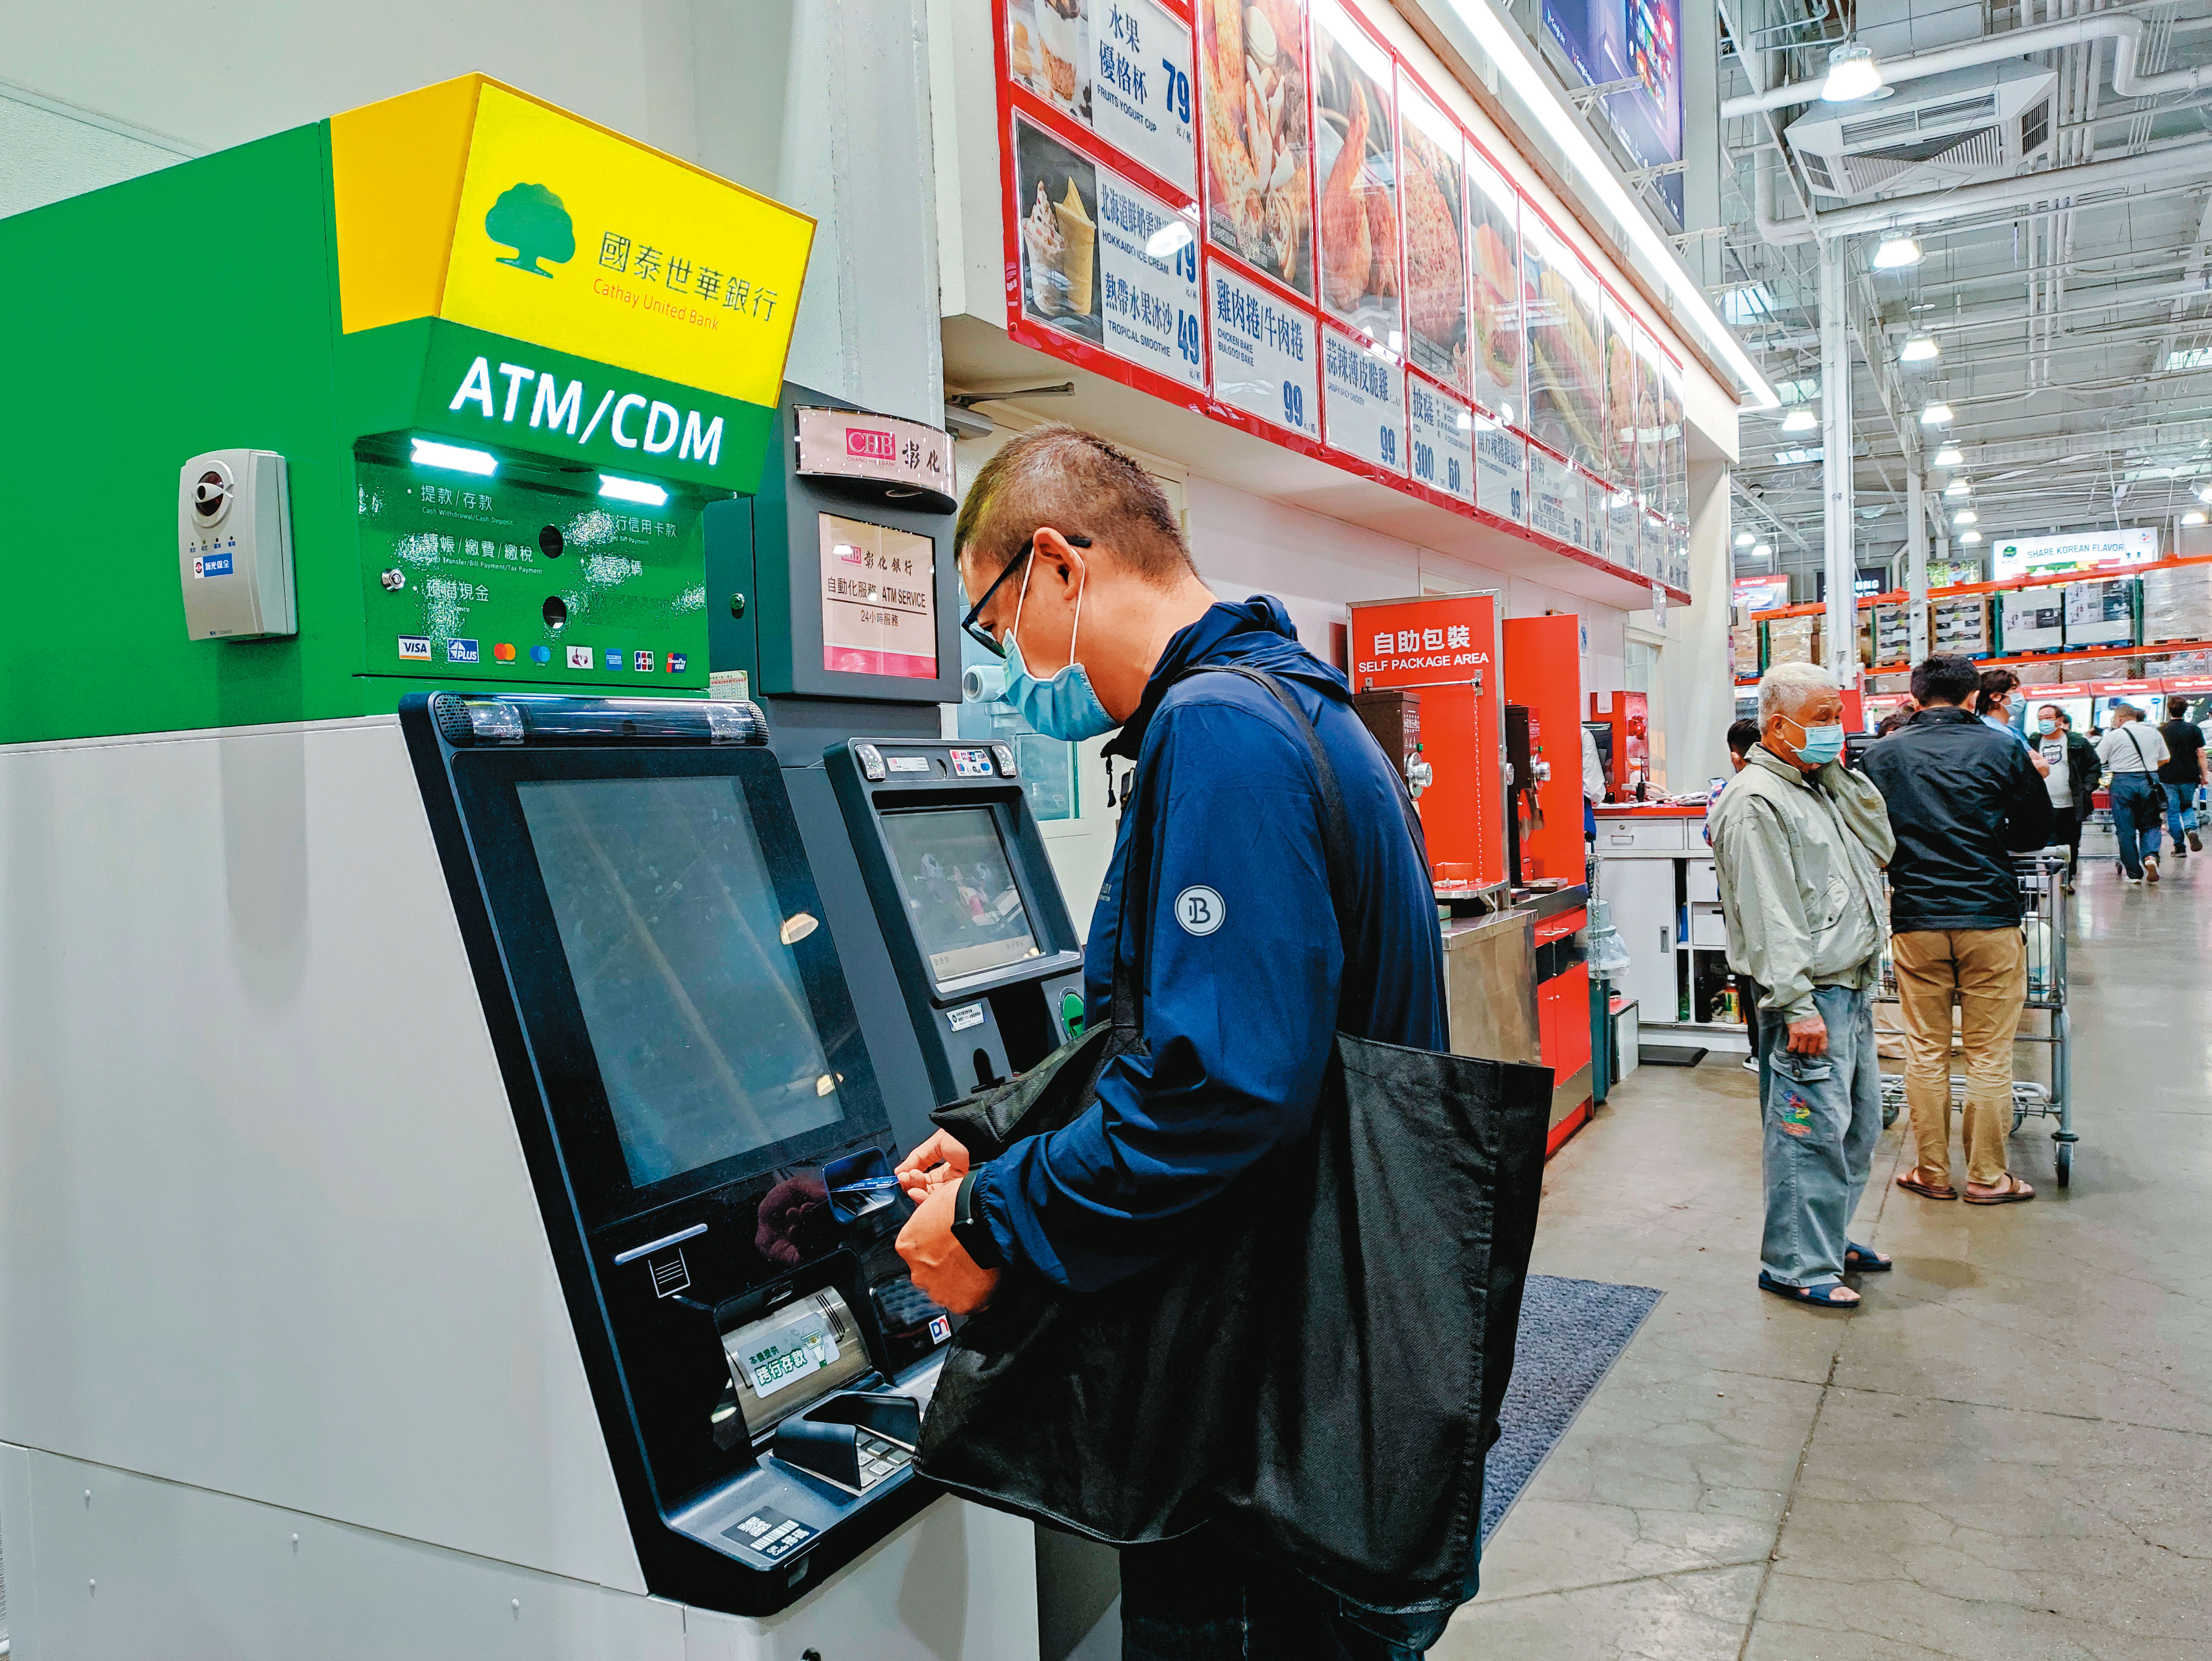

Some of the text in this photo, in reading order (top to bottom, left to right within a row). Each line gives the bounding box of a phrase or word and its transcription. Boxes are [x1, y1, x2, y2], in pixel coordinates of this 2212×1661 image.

[1109, 2, 1140, 53] 水果
[1099, 39, 1147, 105] 優格杯
[1097, 84, 1157, 133] FRUITS YOGURT CUP
[1163, 58, 1190, 124] 79
[1103, 230, 1169, 275] HOKKAIDO ICE CREAM
[598, 230, 776, 321] 國泰世華銀行
[593, 278, 719, 331] Cathay United Bank
[1105, 272, 1173, 335] 熱帶水果冰沙
[1108, 319, 1170, 357] TROPICAL SMOOTHIE
[1178, 309, 1198, 365] 49
[1218, 328, 1253, 354] CHICKEN BAKE
[1218, 341, 1254, 367] BULGOGI BAKE
[449, 355, 724, 465] ATM/CDM
[1283, 380, 1303, 427] 99
[1413, 385, 1434, 427] 披薩
[848, 432, 894, 457] CHB
[902, 437, 940, 473] 彰化
[1380, 425, 1395, 465] 99
[1415, 441, 1434, 481] 300
[1449, 456, 1460, 492] 60
[421, 484, 494, 512] 提款/存款
[422, 506, 513, 526] Cash Withdrawal/Cash Deposit
[1511, 487, 1520, 519] 99
[205, 560, 229, 571] 新光保全
[864, 550, 913, 577] 彰化銀行
[2027, 548, 2054, 559] SHARE
[2057, 545, 2089, 554] KOREAN
[2092, 543, 2124, 552] FLAVOR
[519, 566, 542, 575] Payment
[882, 586, 926, 608] ATM SERVICE
[861, 609, 898, 626] 24小時服務
[403, 642, 428, 653] VISA
[457, 650, 477, 661] PLUS
[1373, 624, 1471, 656] 自助包裝
[1358, 652, 1489, 673] SELF PACKAGE AREA
[1188, 897, 1211, 924] B
[754, 1348, 807, 1386] 跨行存款
